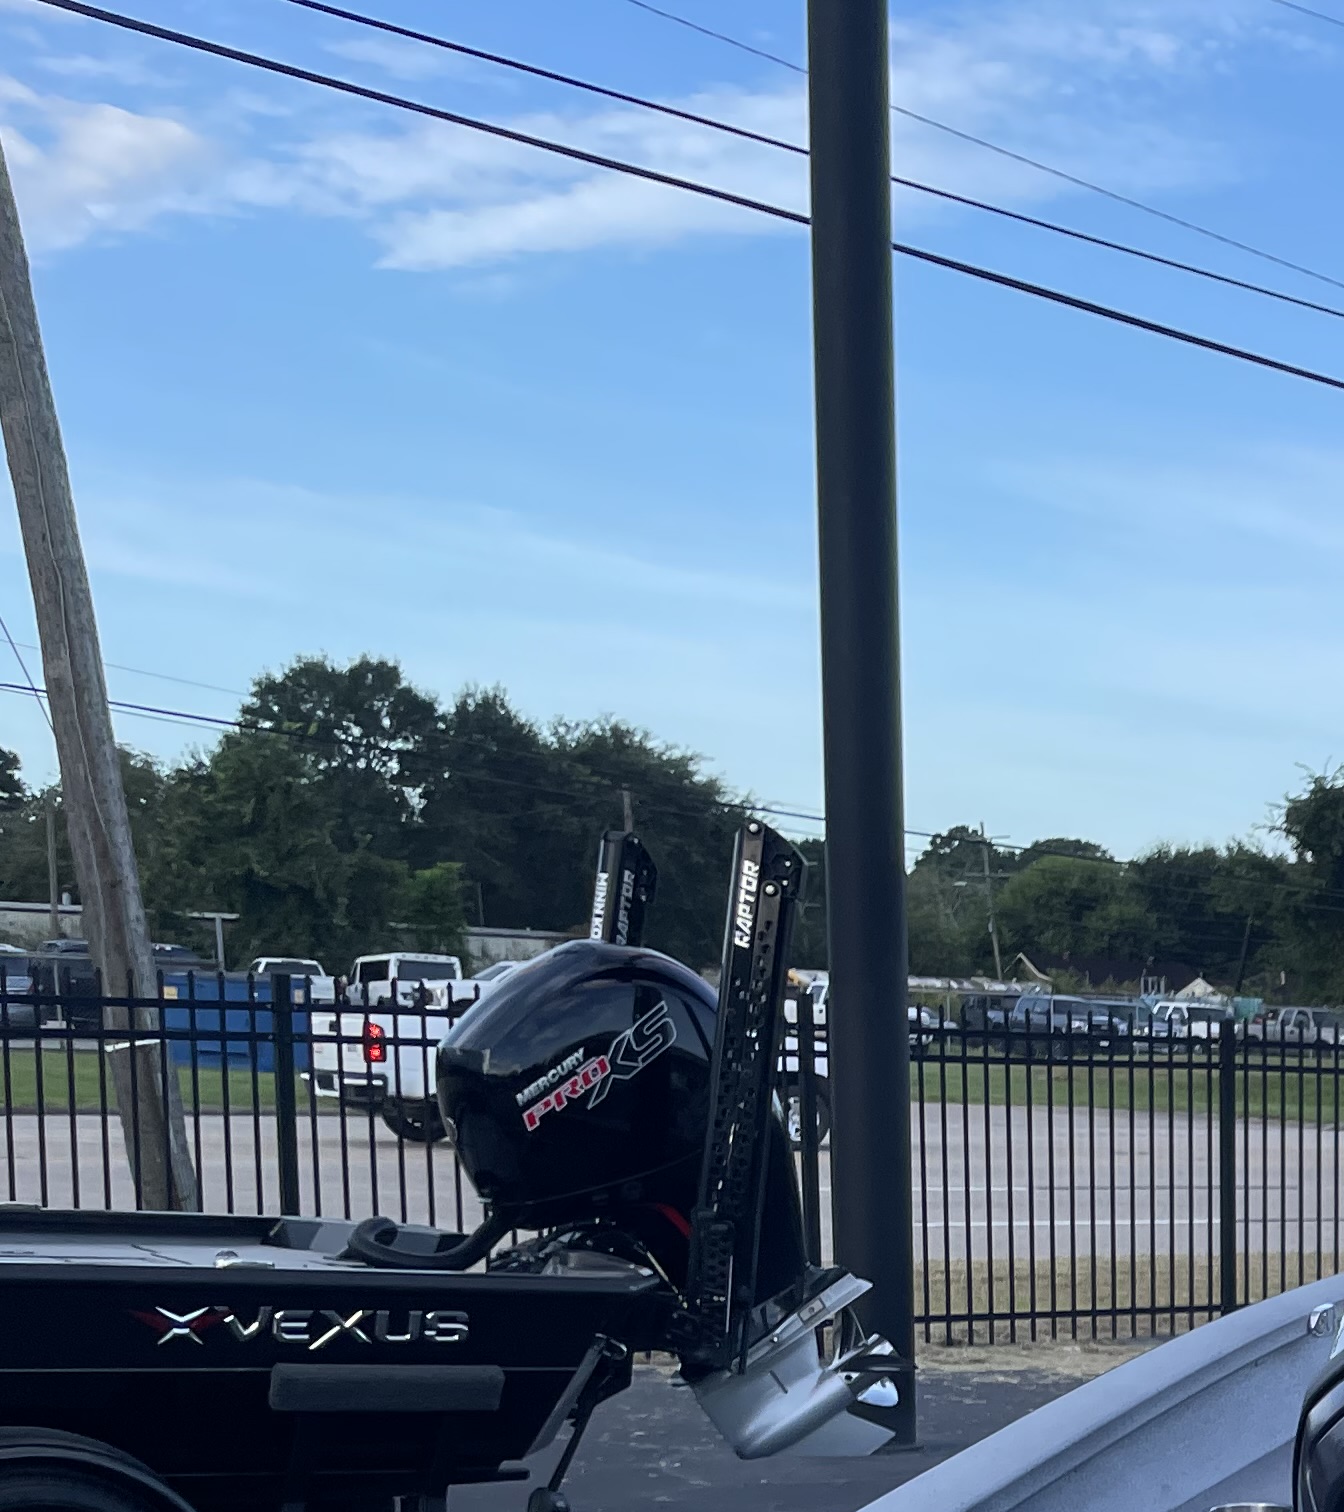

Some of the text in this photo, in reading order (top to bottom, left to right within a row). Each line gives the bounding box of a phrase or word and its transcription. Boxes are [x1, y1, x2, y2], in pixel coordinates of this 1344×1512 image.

[734, 859, 760, 950] RAPTOR
[515, 1046, 585, 1107] MERCURY
[522, 1000, 677, 1132] PRO XS
[213, 1305, 469, 1350] VEXUS
